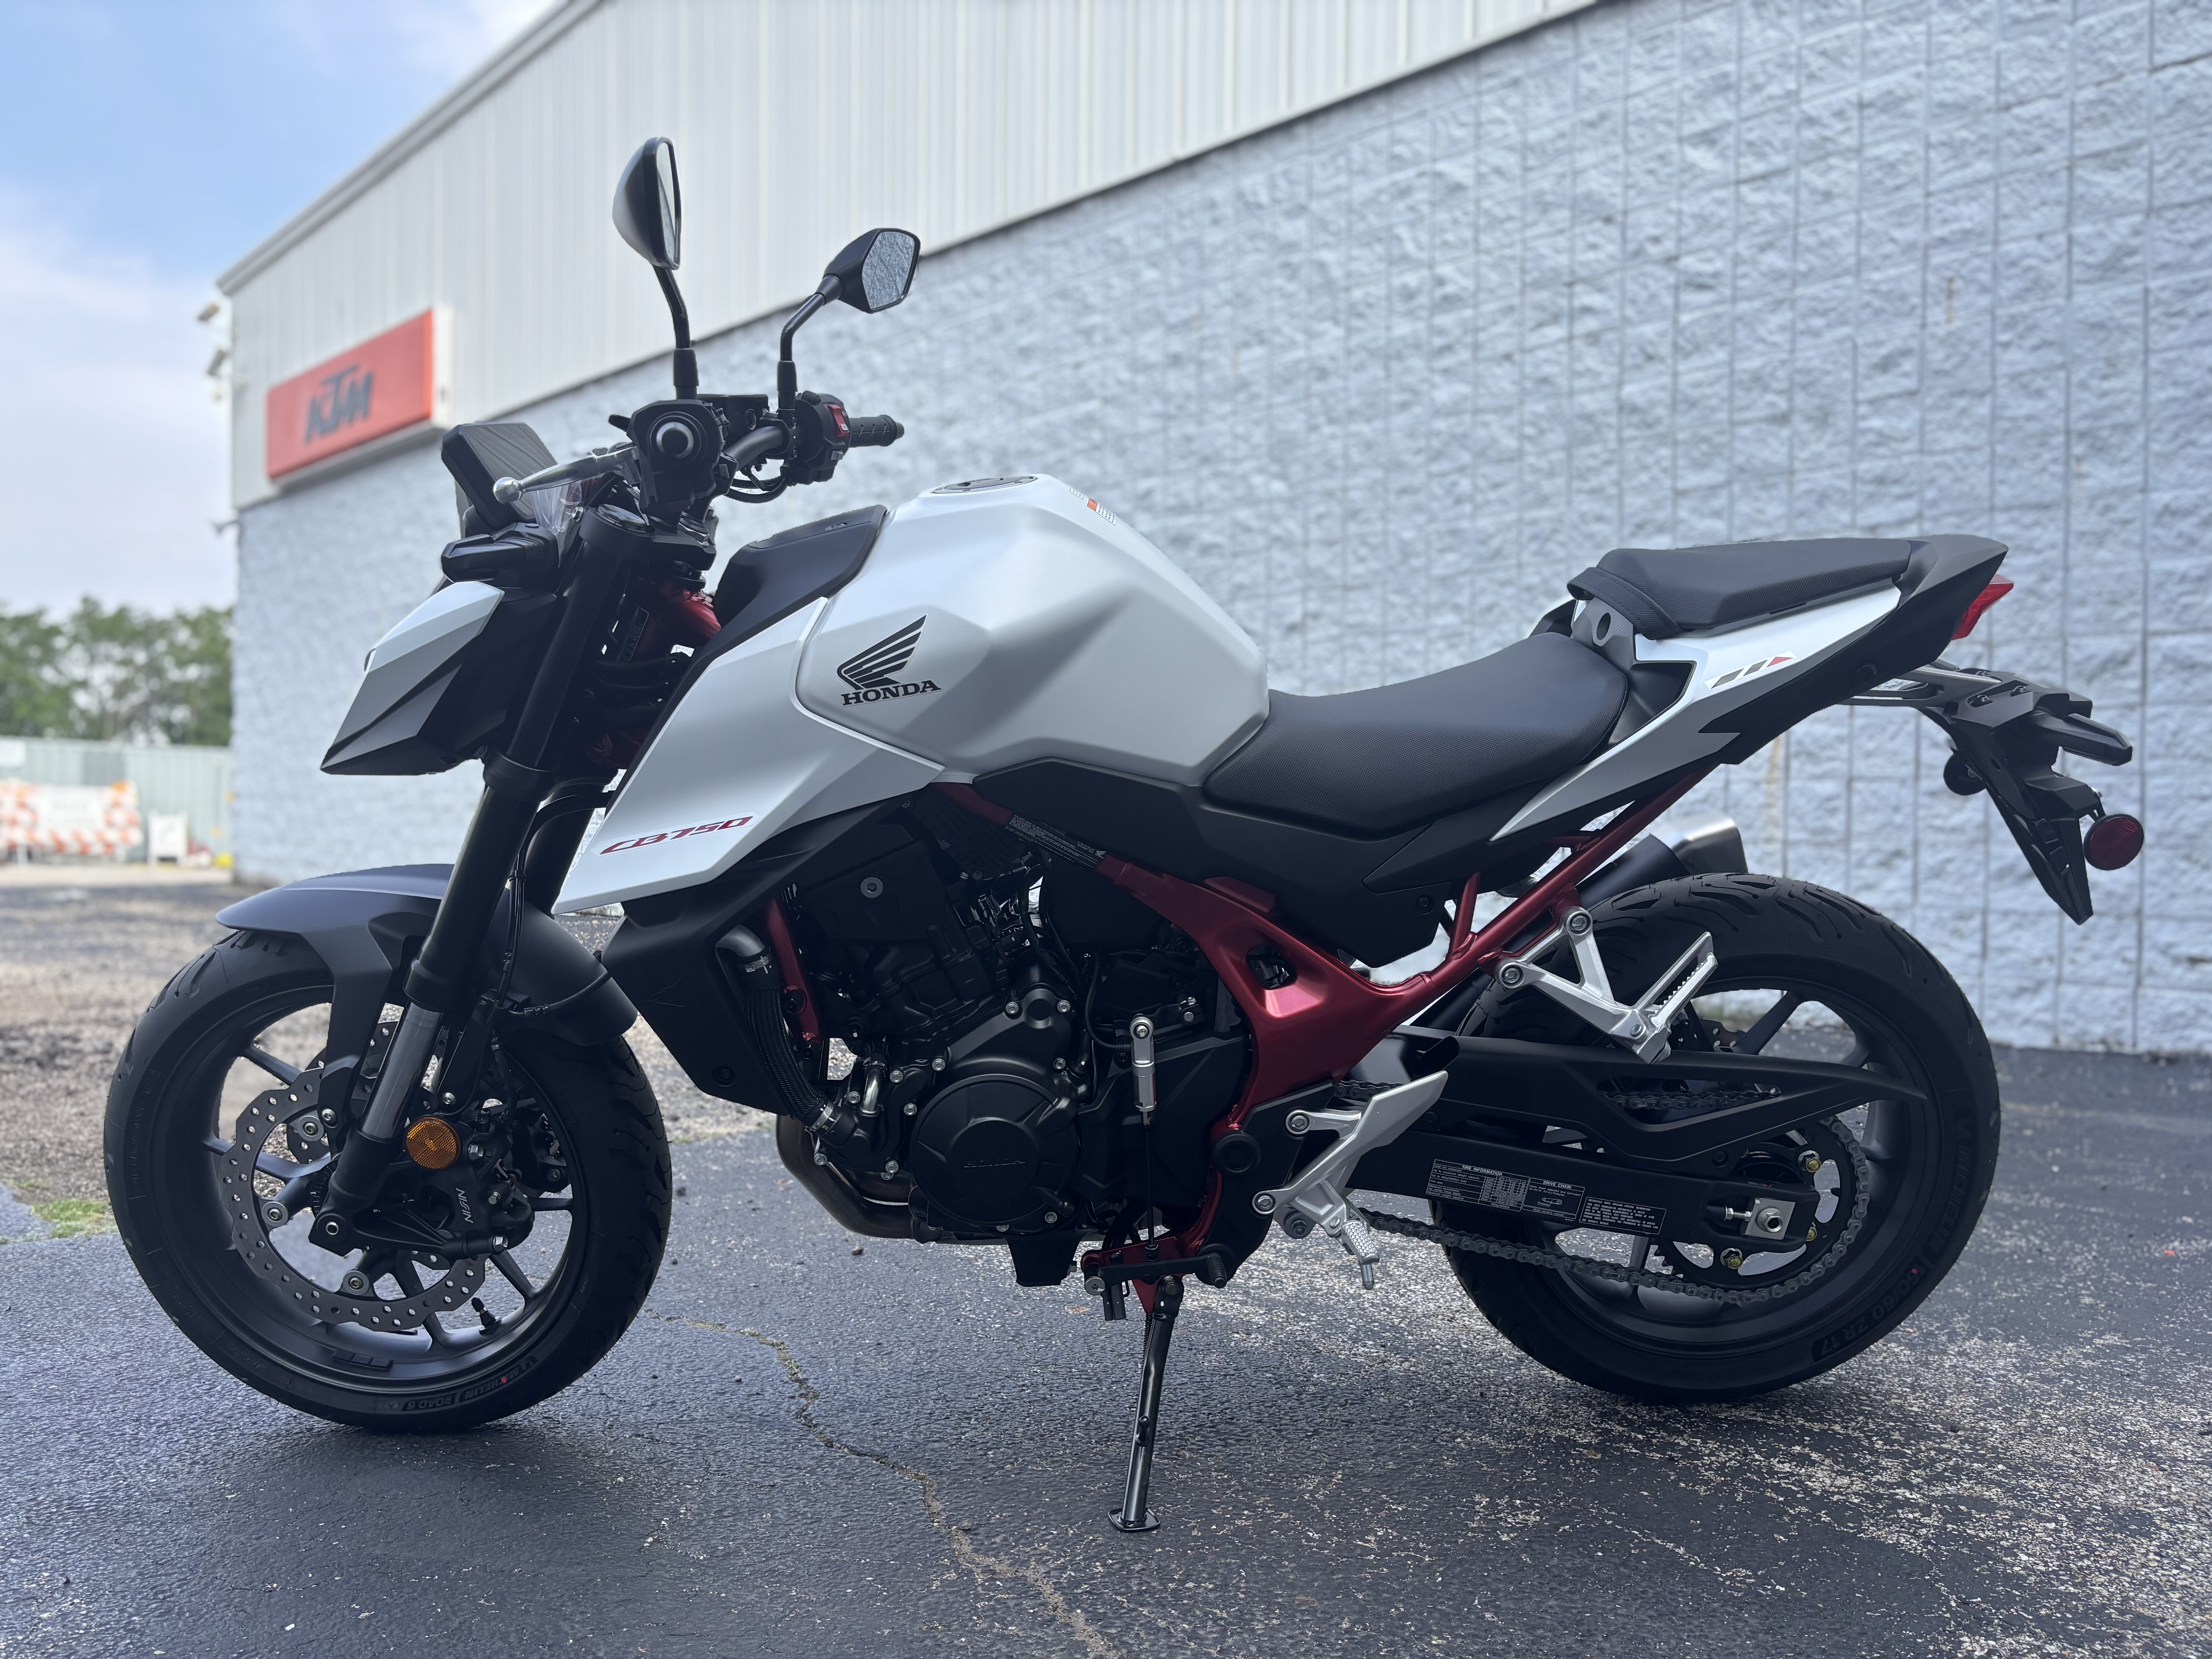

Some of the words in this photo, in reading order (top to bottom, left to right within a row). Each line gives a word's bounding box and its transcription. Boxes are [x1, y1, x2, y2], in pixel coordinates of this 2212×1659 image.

[303, 363, 374, 444] KTM
[841, 680, 941, 706] HONDA
[600, 816, 753, 855] CB750
[1473, 1167, 1502, 1175] INFORMATION
[1843, 1316, 1868, 1340] ZR
[1822, 1336, 1839, 1355] 17
[407, 1401, 415, 1410] 6
[419, 1396, 452, 1408] ROAD
